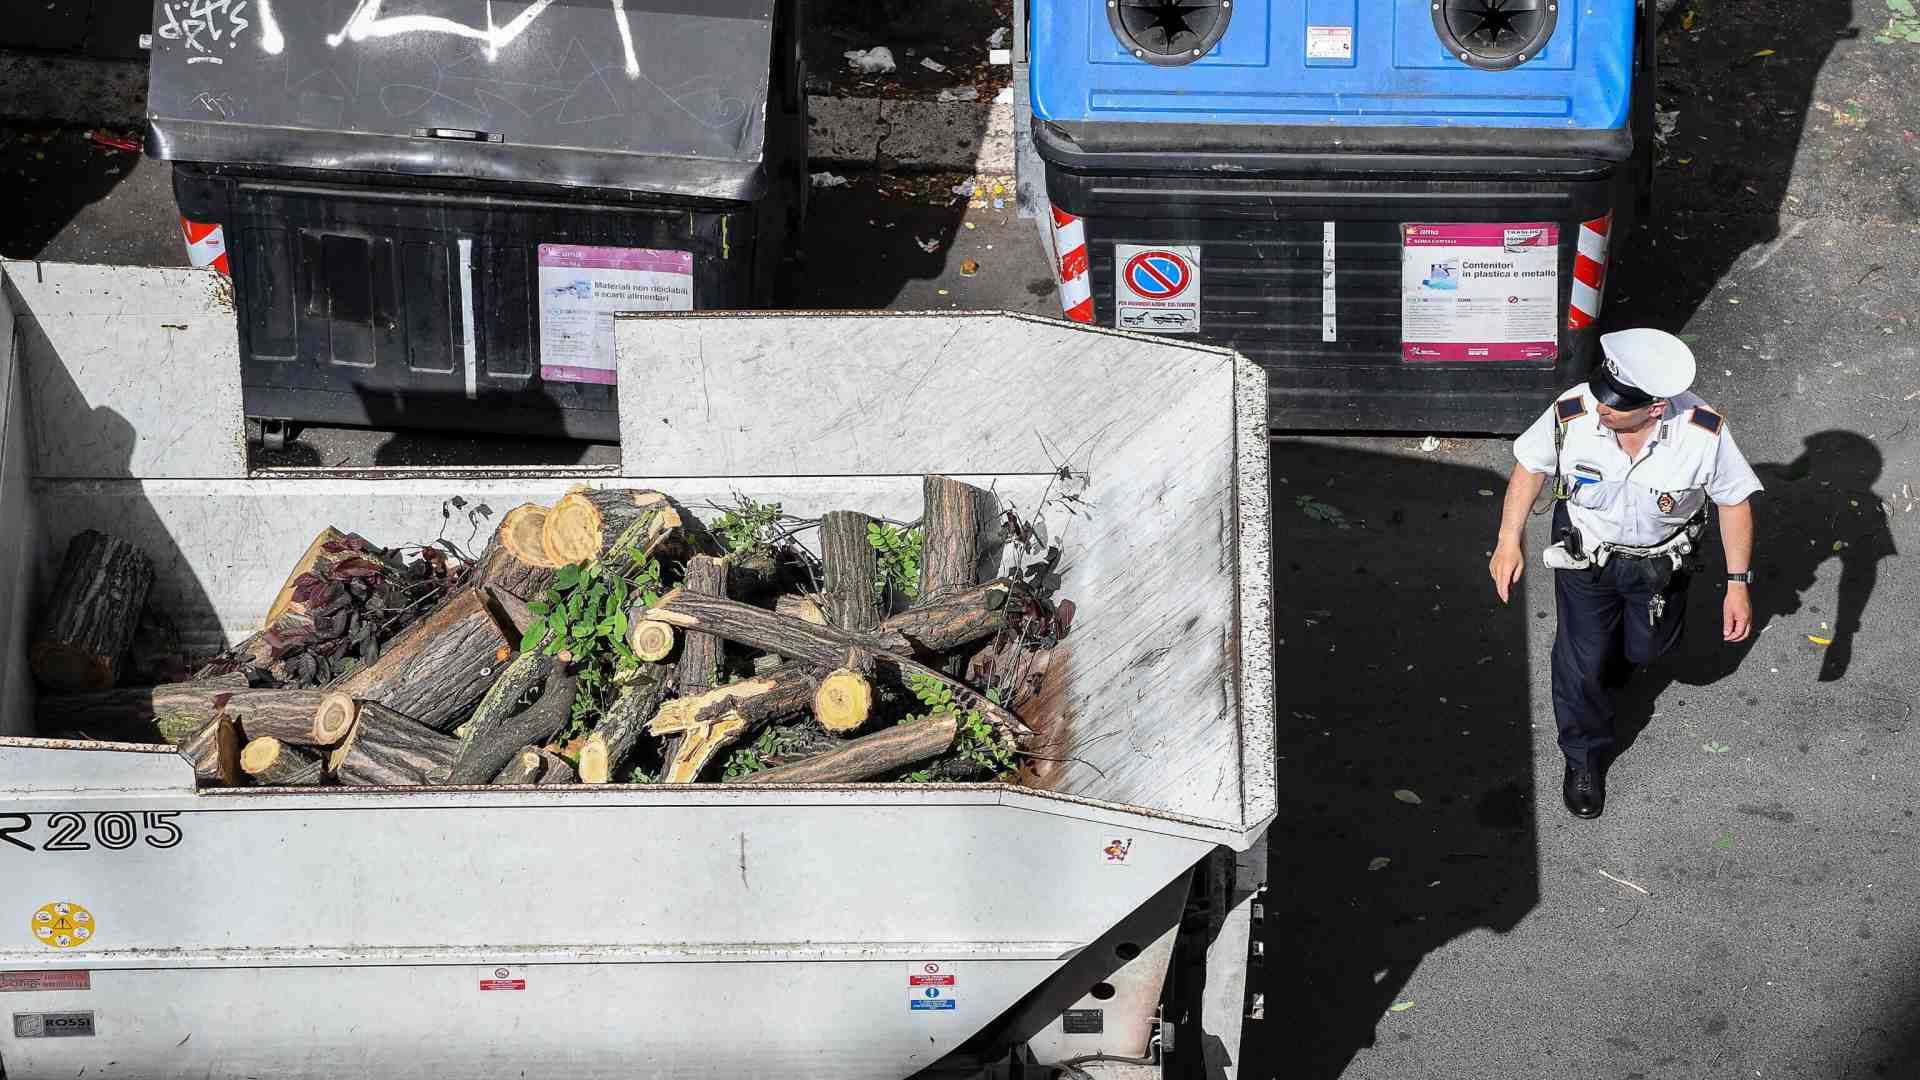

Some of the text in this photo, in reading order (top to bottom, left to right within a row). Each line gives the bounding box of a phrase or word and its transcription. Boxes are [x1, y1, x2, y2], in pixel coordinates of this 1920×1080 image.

[1462, 261, 1514, 269] Contenitori
[1462, 270, 1471, 278] in
[1473, 270, 1511, 279] plastica
[1521, 270, 1556, 278] metallo
[594, 281, 631, 291] Materiali
[45, 1018, 91, 1027] ROSSI
